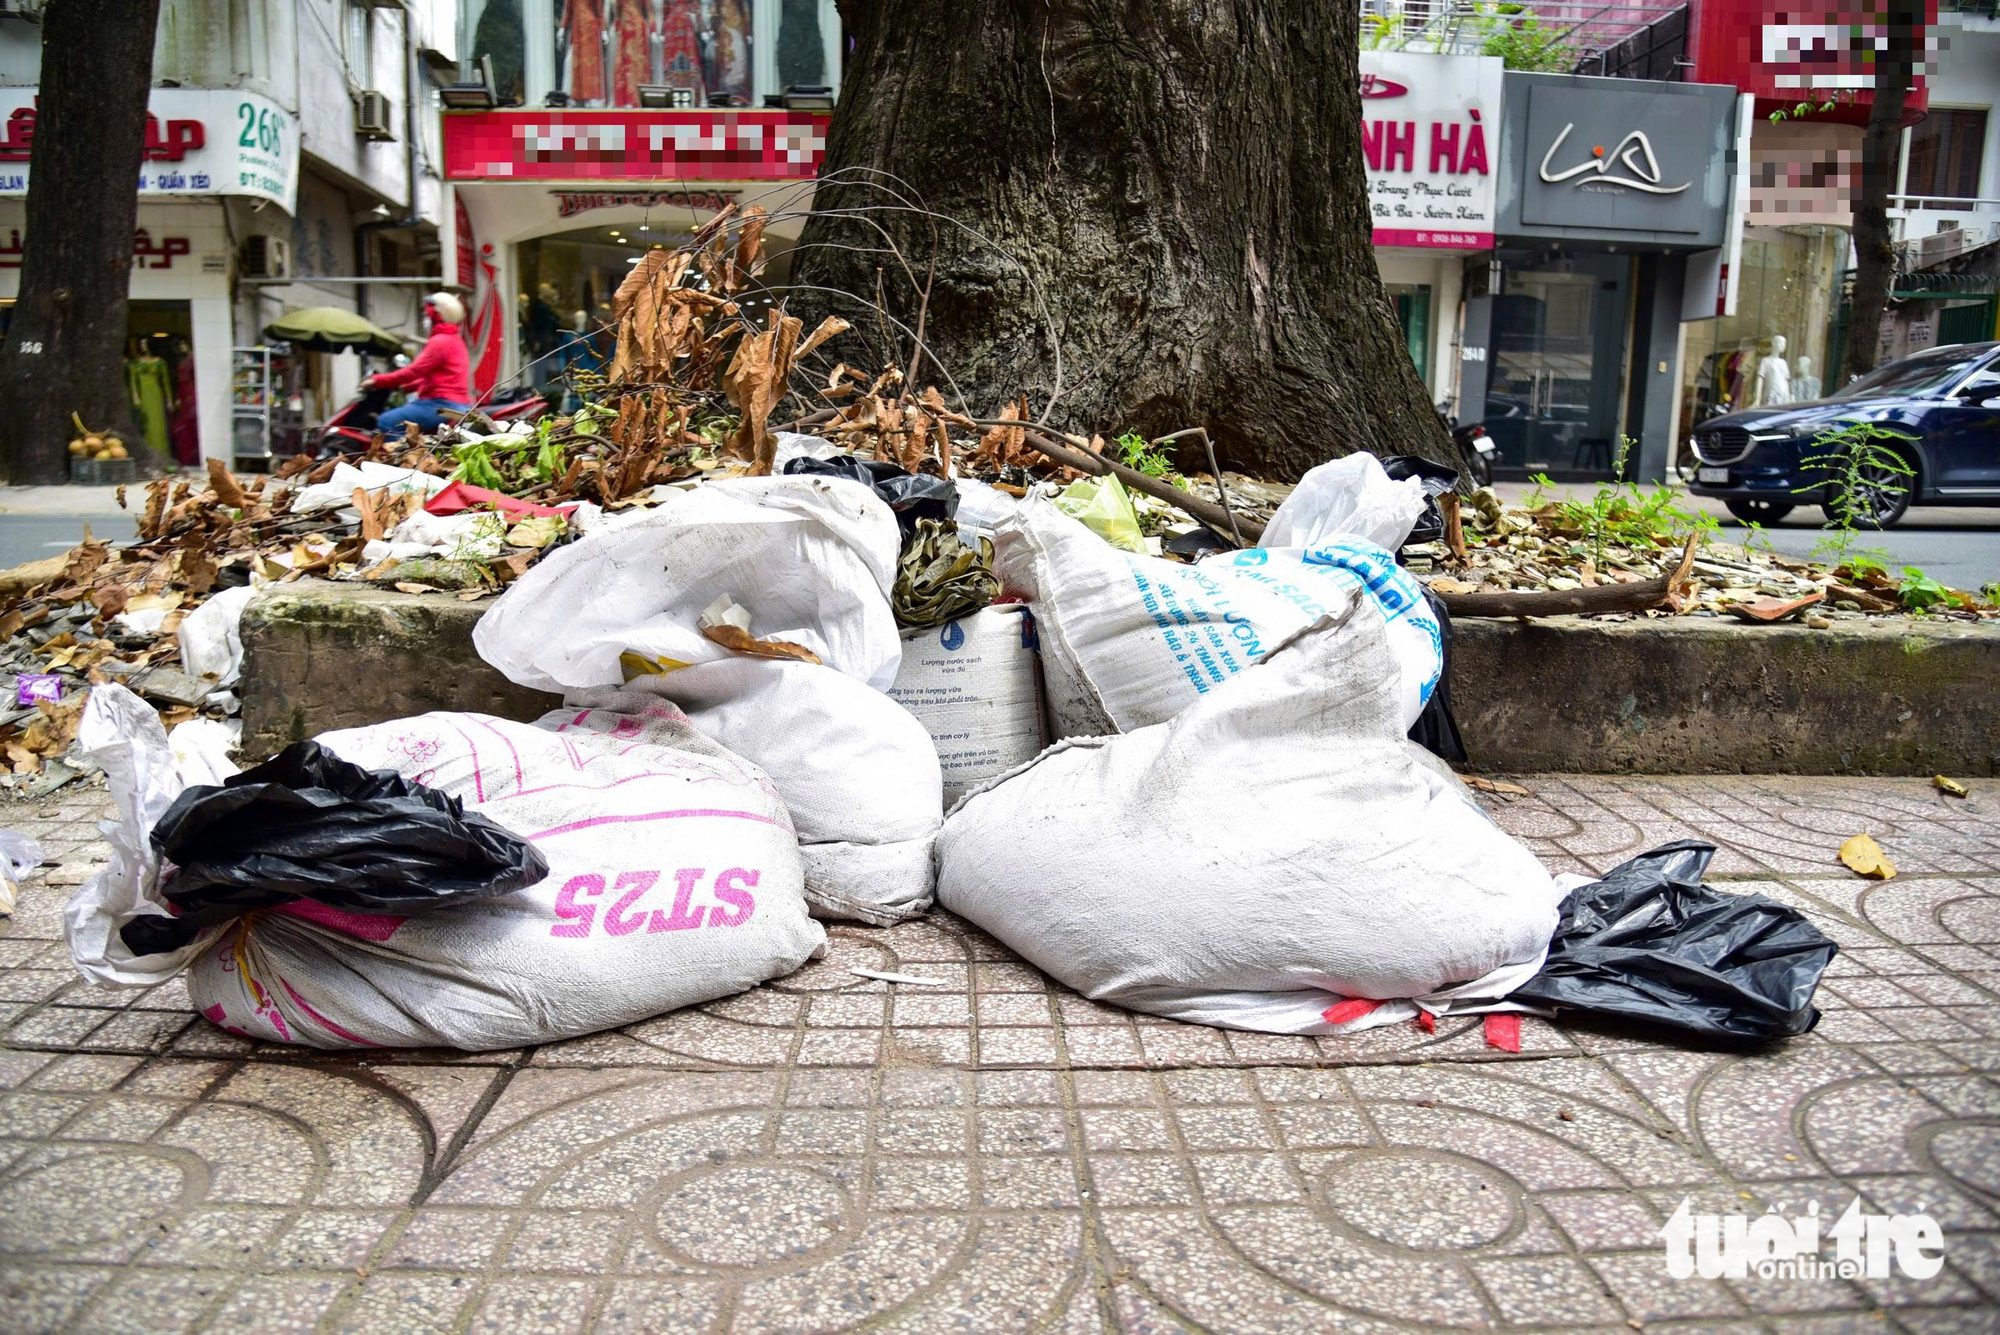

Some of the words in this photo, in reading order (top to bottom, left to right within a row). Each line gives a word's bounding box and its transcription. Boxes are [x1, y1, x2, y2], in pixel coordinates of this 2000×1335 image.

[1430, 108, 1489, 176] HÀ
[921, 659, 945, 667] Lượng
[946, 657, 964, 665] nước
[886, 687, 902, 695] 0kg
[925, 687, 947, 695] lượng
[951, 752, 963, 760] ghi
[550, 867, 761, 938] ST25
